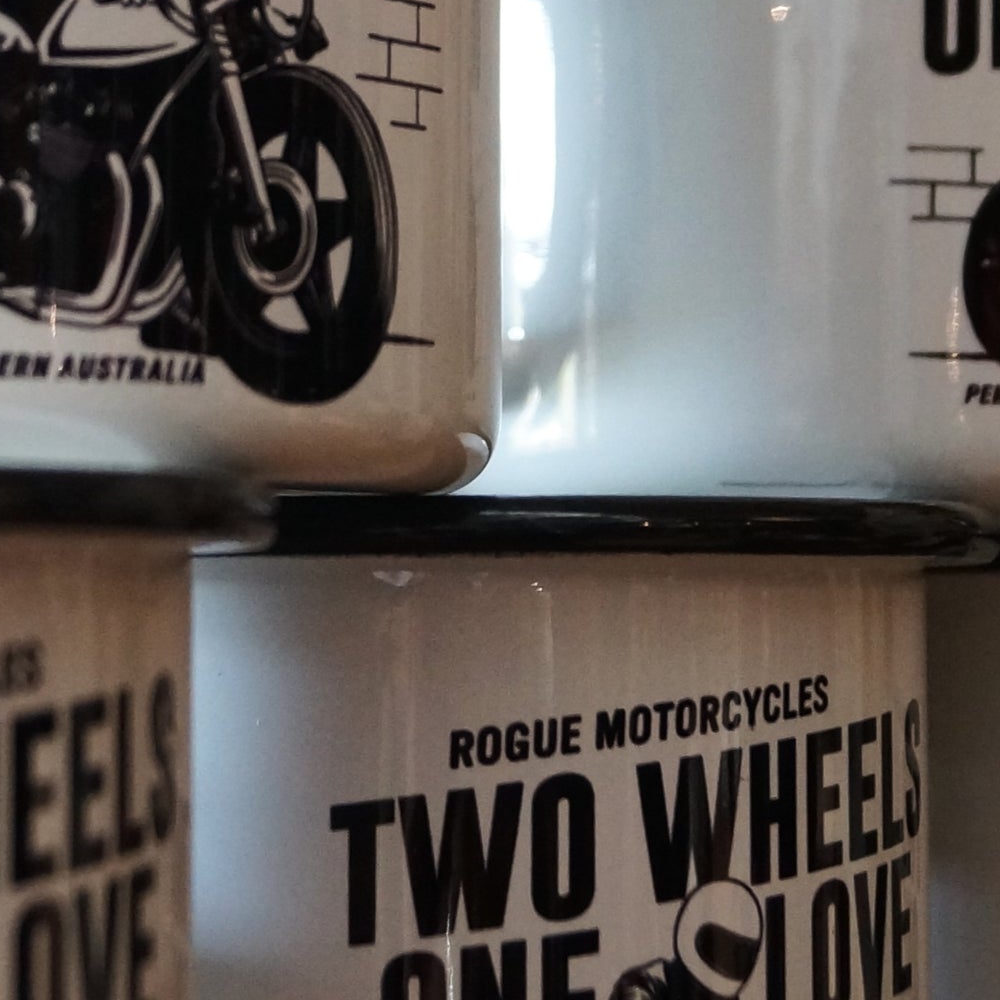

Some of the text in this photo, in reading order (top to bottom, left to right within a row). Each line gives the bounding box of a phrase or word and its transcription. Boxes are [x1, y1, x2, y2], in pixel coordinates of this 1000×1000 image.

[57, 353, 207, 385] AUSTRALIA
[449, 674, 830, 769] ROGUE MOTORCYCLES
[329, 699, 922, 947] TWO WHEELS
[765, 851, 912, 1000] LOVE
